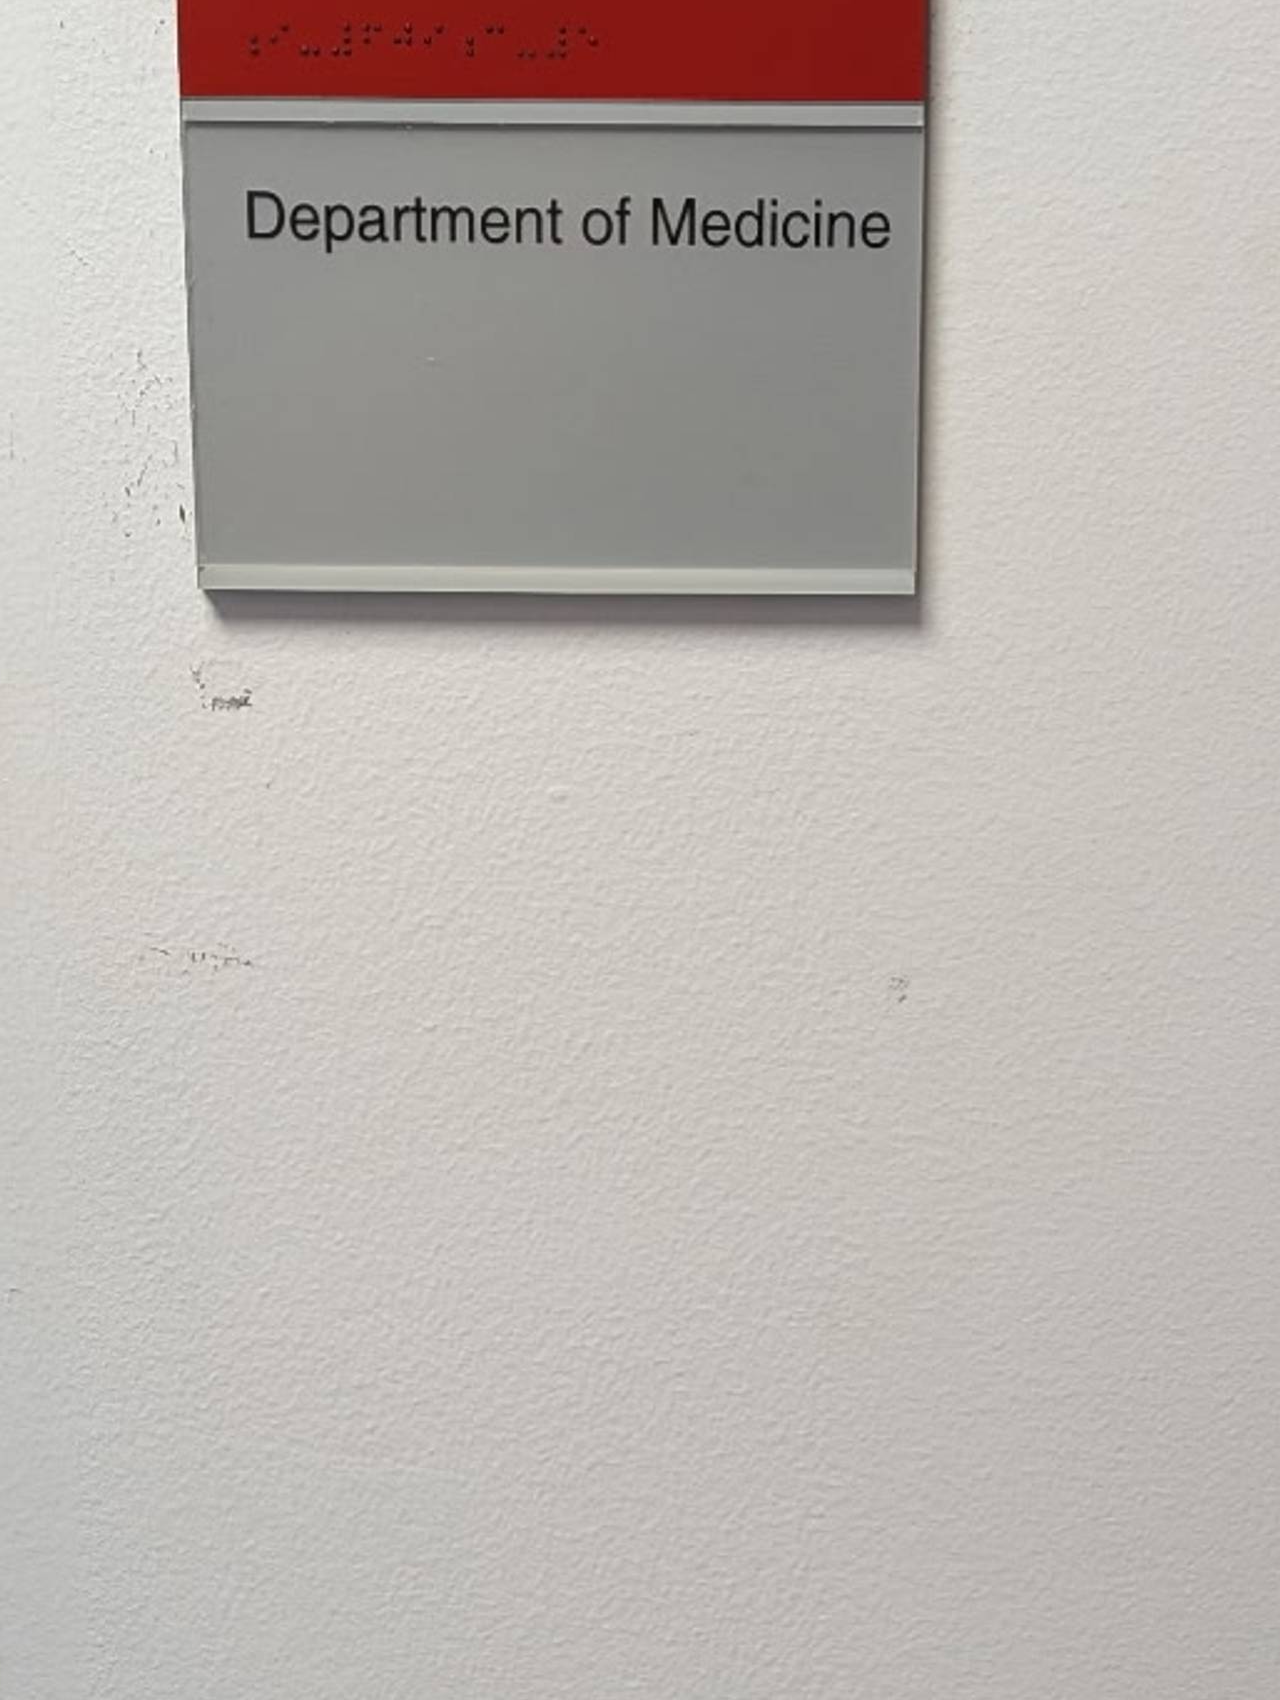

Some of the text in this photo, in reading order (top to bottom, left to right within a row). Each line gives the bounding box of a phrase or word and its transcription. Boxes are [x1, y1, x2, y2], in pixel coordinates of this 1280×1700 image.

[245, 190, 892, 254] Department of Medicine
